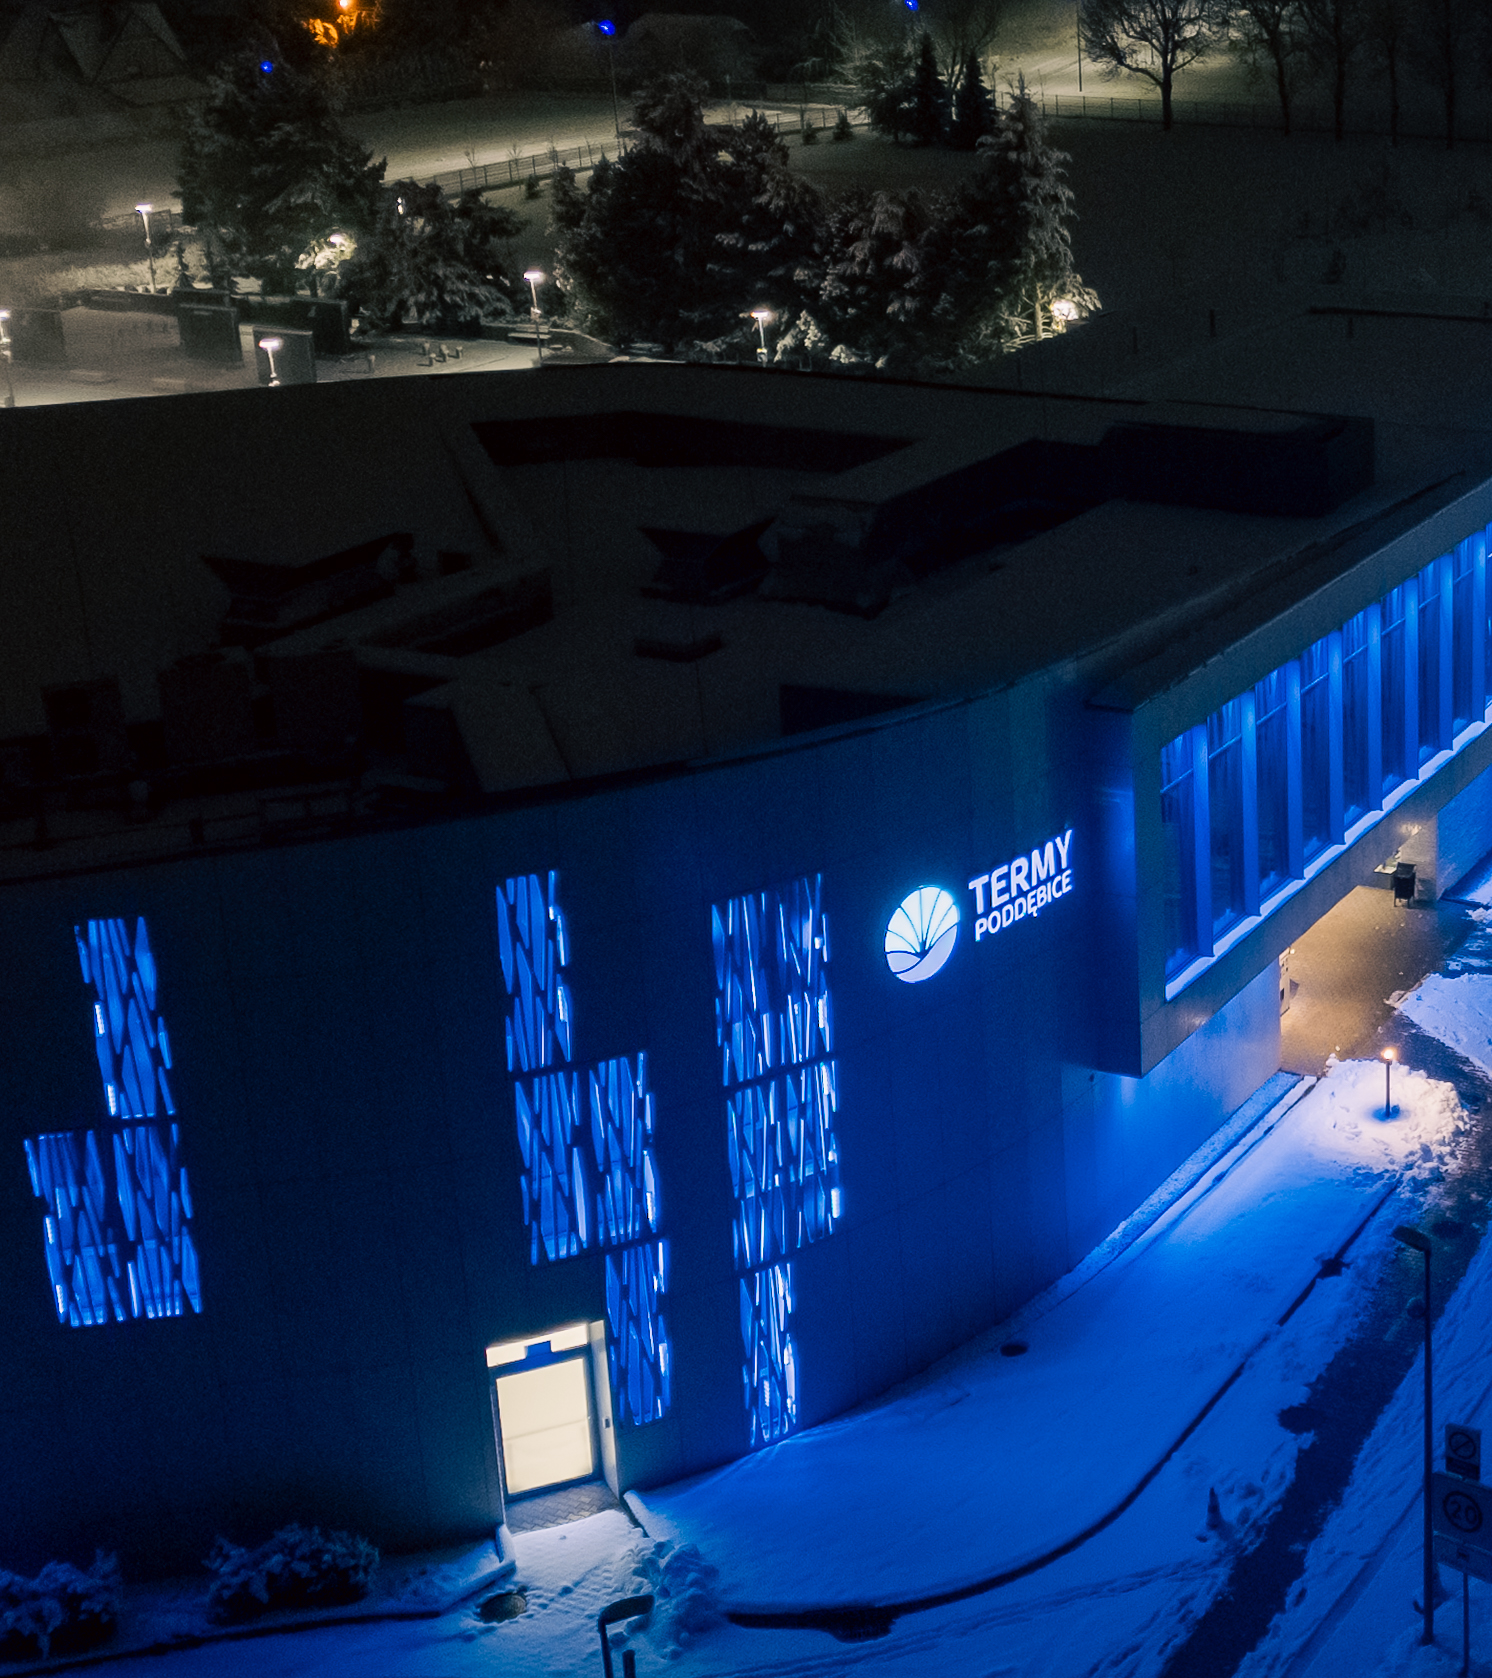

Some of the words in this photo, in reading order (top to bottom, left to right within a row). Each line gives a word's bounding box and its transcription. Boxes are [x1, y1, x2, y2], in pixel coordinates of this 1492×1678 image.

[968, 829, 1072, 915] TERMY
[974, 869, 1072, 942] PODDĘBICE
[1450, 1500, 1477, 1524] 20
